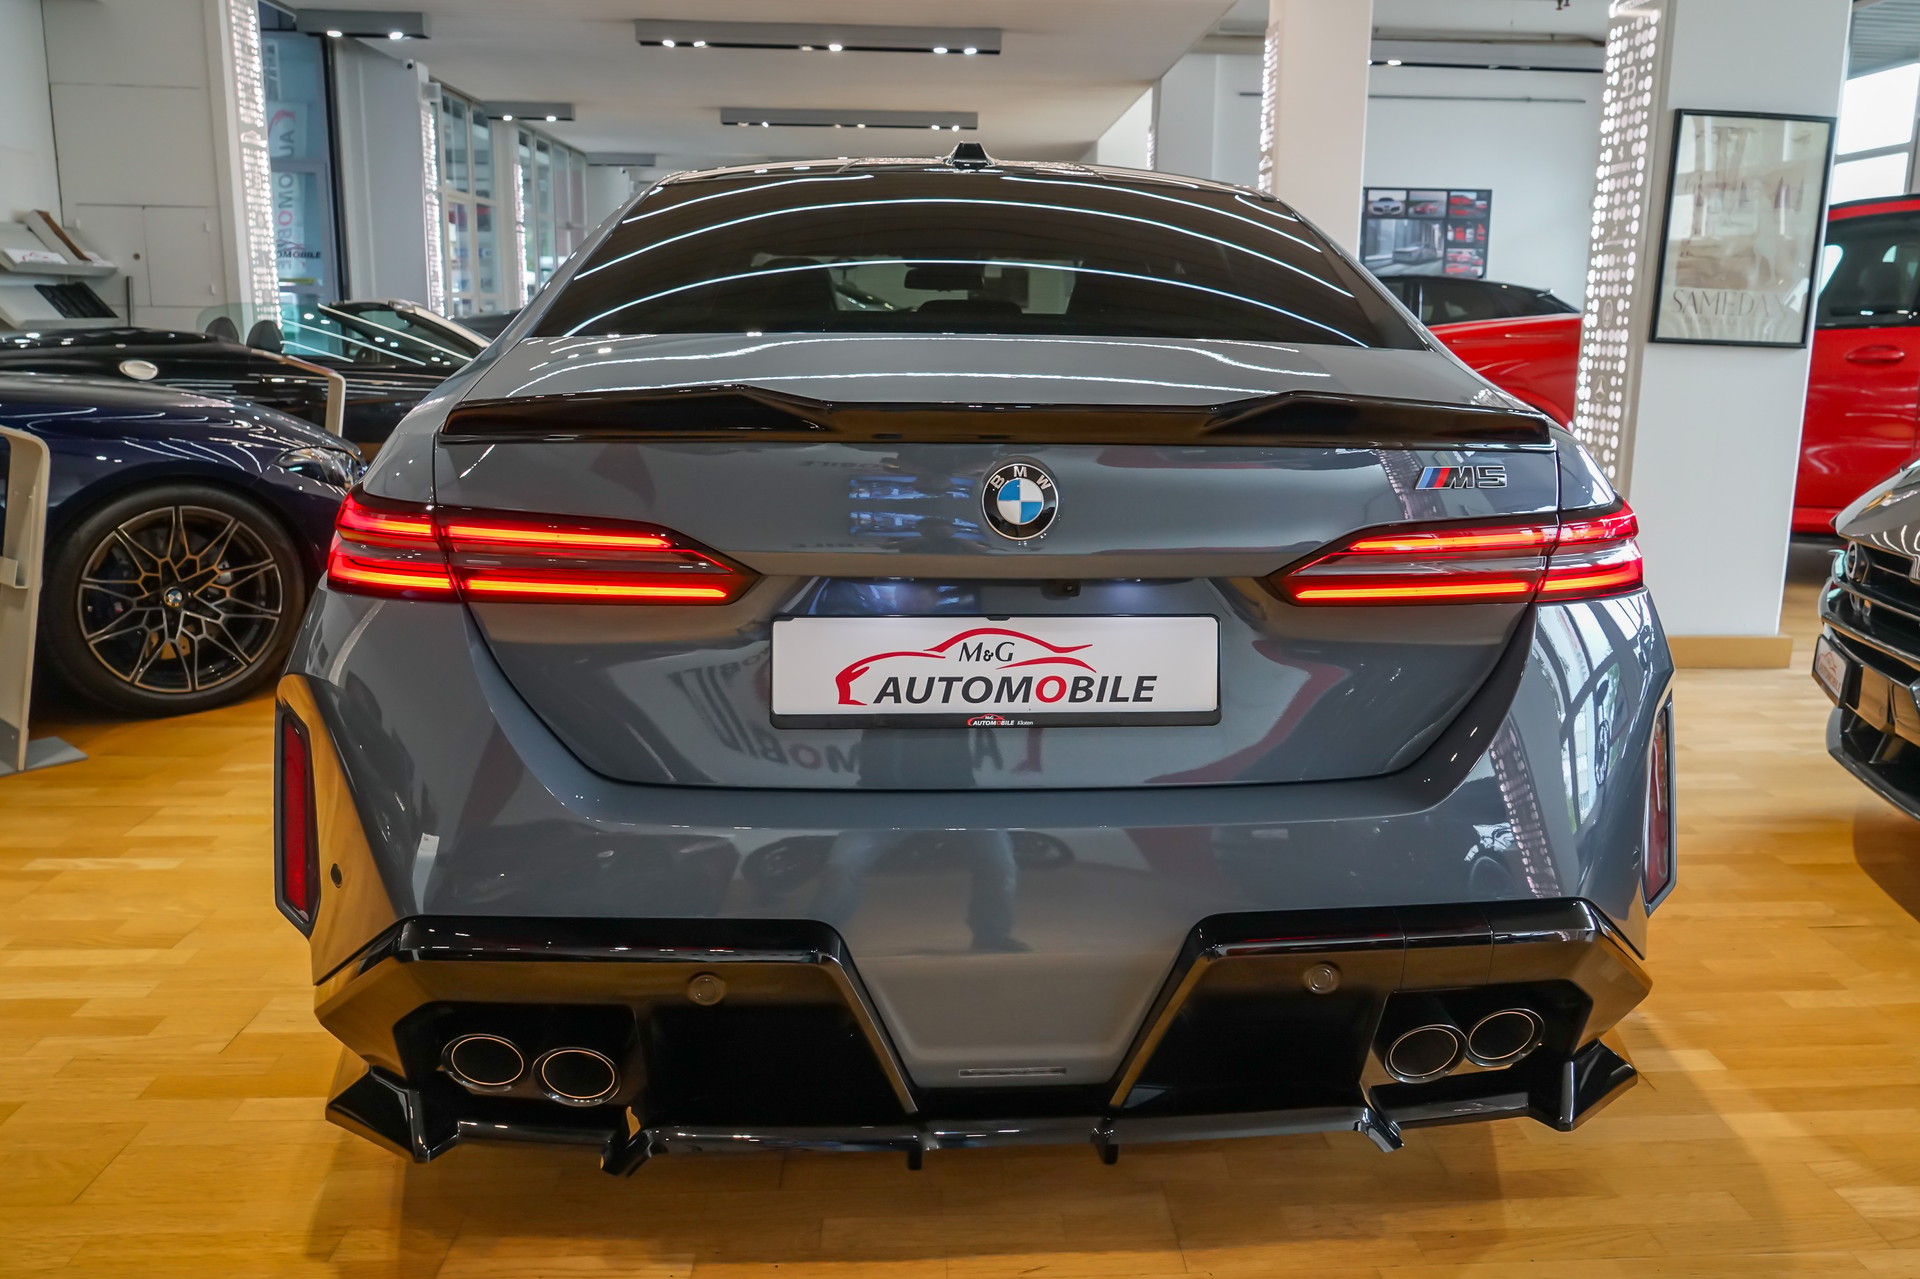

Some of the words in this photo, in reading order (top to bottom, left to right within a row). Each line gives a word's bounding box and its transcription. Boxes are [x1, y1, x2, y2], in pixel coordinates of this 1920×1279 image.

[990, 466, 1051, 490] BMW
[1440, 466, 1507, 488] M5
[958, 641, 1015, 662] M&G
[873, 675, 1157, 704] AUTOMOBILE
